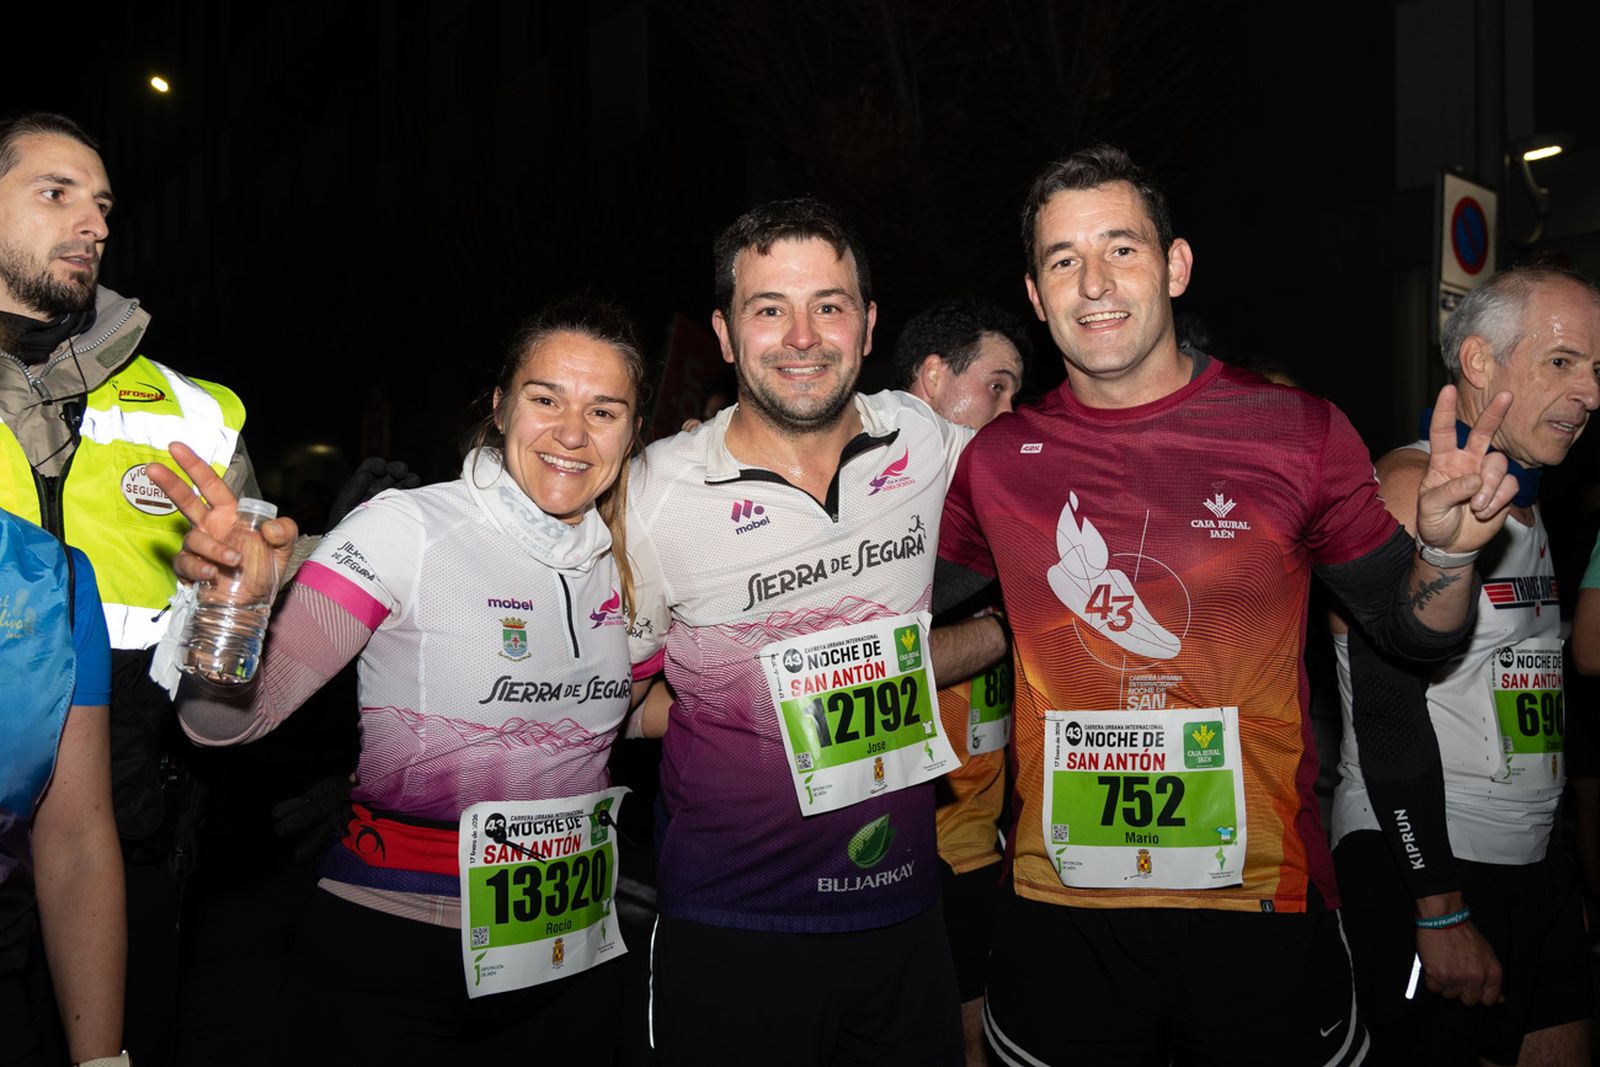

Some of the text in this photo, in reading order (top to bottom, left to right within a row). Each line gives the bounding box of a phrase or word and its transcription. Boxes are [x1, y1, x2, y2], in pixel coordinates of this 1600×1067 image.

[126, 483, 169, 499] SEGURI
[735, 516, 771, 535] mobel
[1218, 520, 1251, 530] RURAL
[337, 555, 376, 582] SEGURA
[743, 534, 925, 612] SIERRA DE SEGURA
[488, 597, 534, 611] mobel
[1085, 584, 1135, 632] 43
[785, 652, 802, 667] 43
[807, 640, 882, 670] NOCHE DE
[1500, 652, 1514, 663] 43
[1517, 655, 1562, 669] NOCHE DE
[791, 673, 828, 698] SAN
[832, 658, 886, 689] ANTÓN
[1502, 669, 1563, 689] SAN ANTÓN
[478, 675, 563, 705] SIERRA
[564, 684, 582, 698] DE
[1128, 687, 1155, 695] NOCHE
[1127, 692, 1167, 710] SAN
[804, 676, 920, 748] 12792
[1066, 727, 1082, 740] 43
[1085, 731, 1165, 748] NOCHE DE
[867, 740, 887, 754] Jose
[1067, 748, 1166, 771] SAN ANTÓN
[1098, 775, 1186, 827] 752
[508, 816, 583, 837] NOCHE DE
[484, 843, 524, 864] SAN
[527, 831, 582, 860] ANTÓN
[1125, 831, 1160, 844] Mario
[1394, 809, 1425, 870] KIPRUN
[817, 860, 914, 892] BUJARKAY
[486, 851, 606, 924] 13320
[546, 919, 573, 935] Rocío
